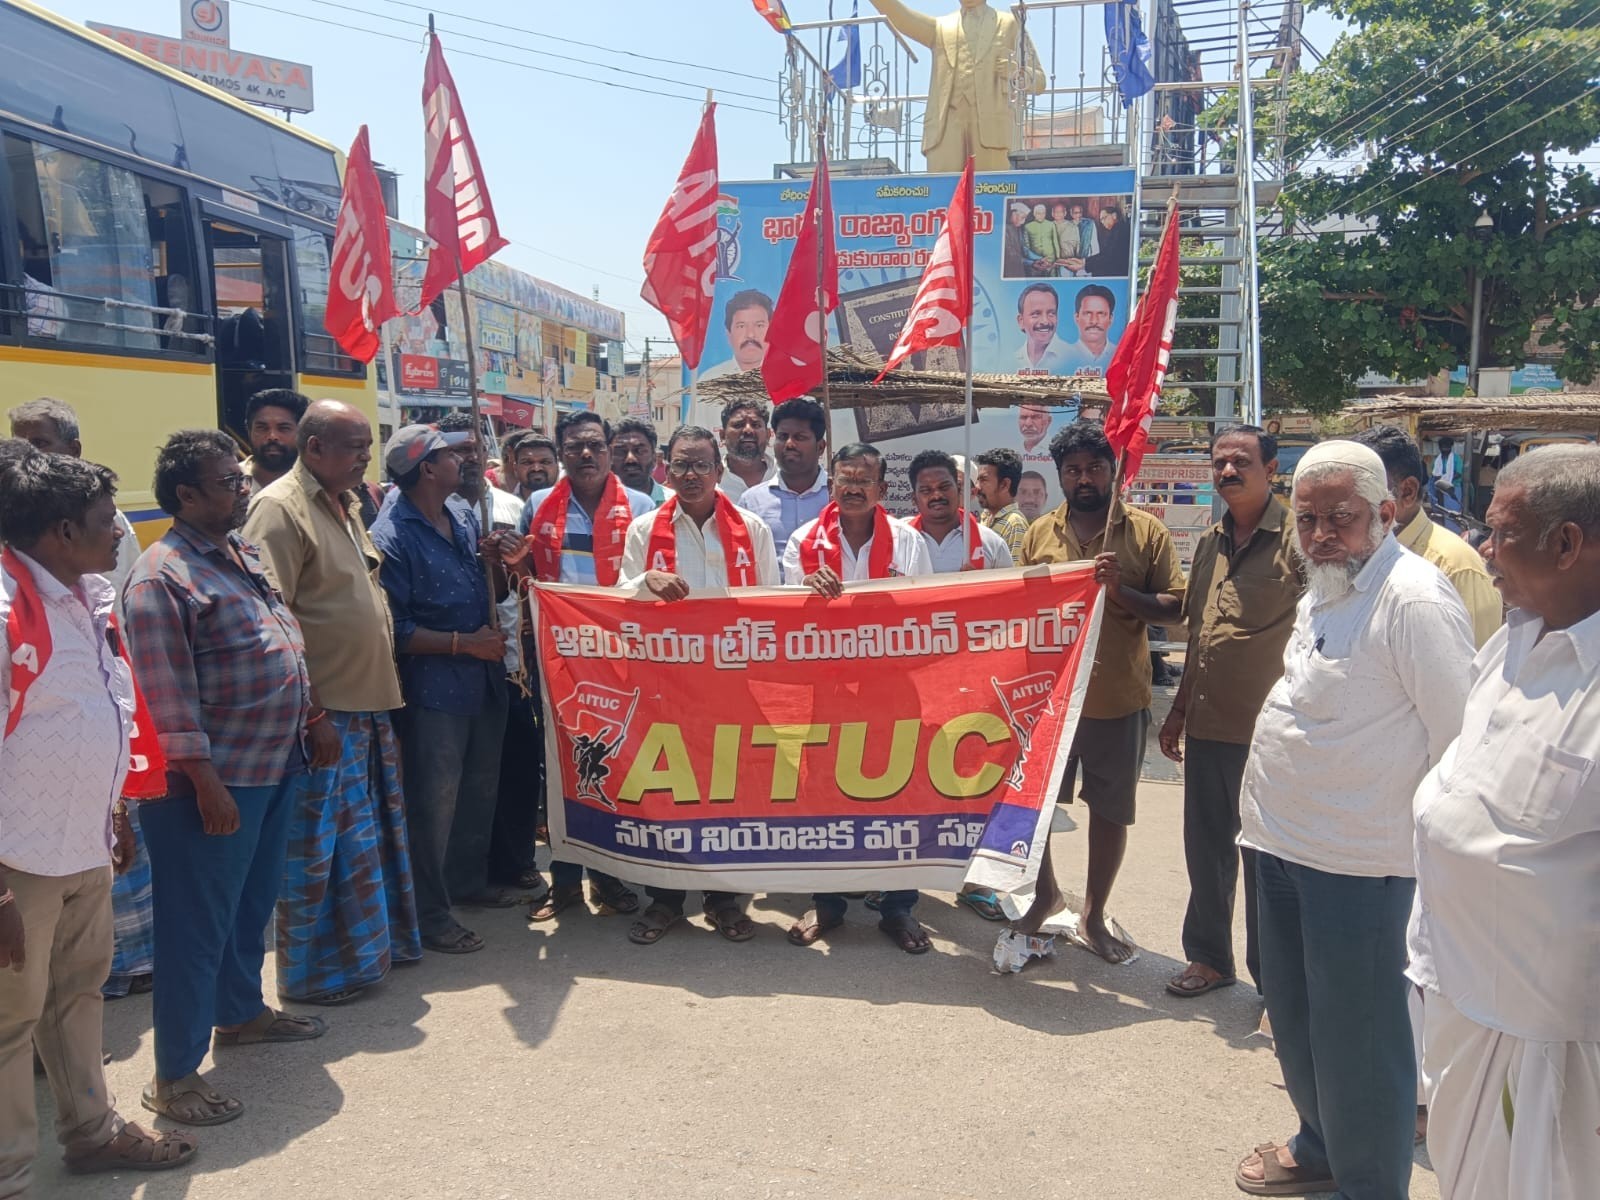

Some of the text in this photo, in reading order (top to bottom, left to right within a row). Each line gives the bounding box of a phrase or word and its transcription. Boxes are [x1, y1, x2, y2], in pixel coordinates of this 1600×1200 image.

[1137, 467, 1209, 479] ENTERPRISES
[551, 601, 1086, 669] ఆలిండియా ట్రేడ్ యూనియన్ కాంగ్రెస్
[577, 692, 620, 711] AITUC
[1012, 679, 1052, 701] AITUC
[617, 712, 1012, 803] AITUC
[615, 820, 693, 854] నగరి
[700, 821, 856, 853] నియోజక
[864, 820, 921, 861] వర్గ
